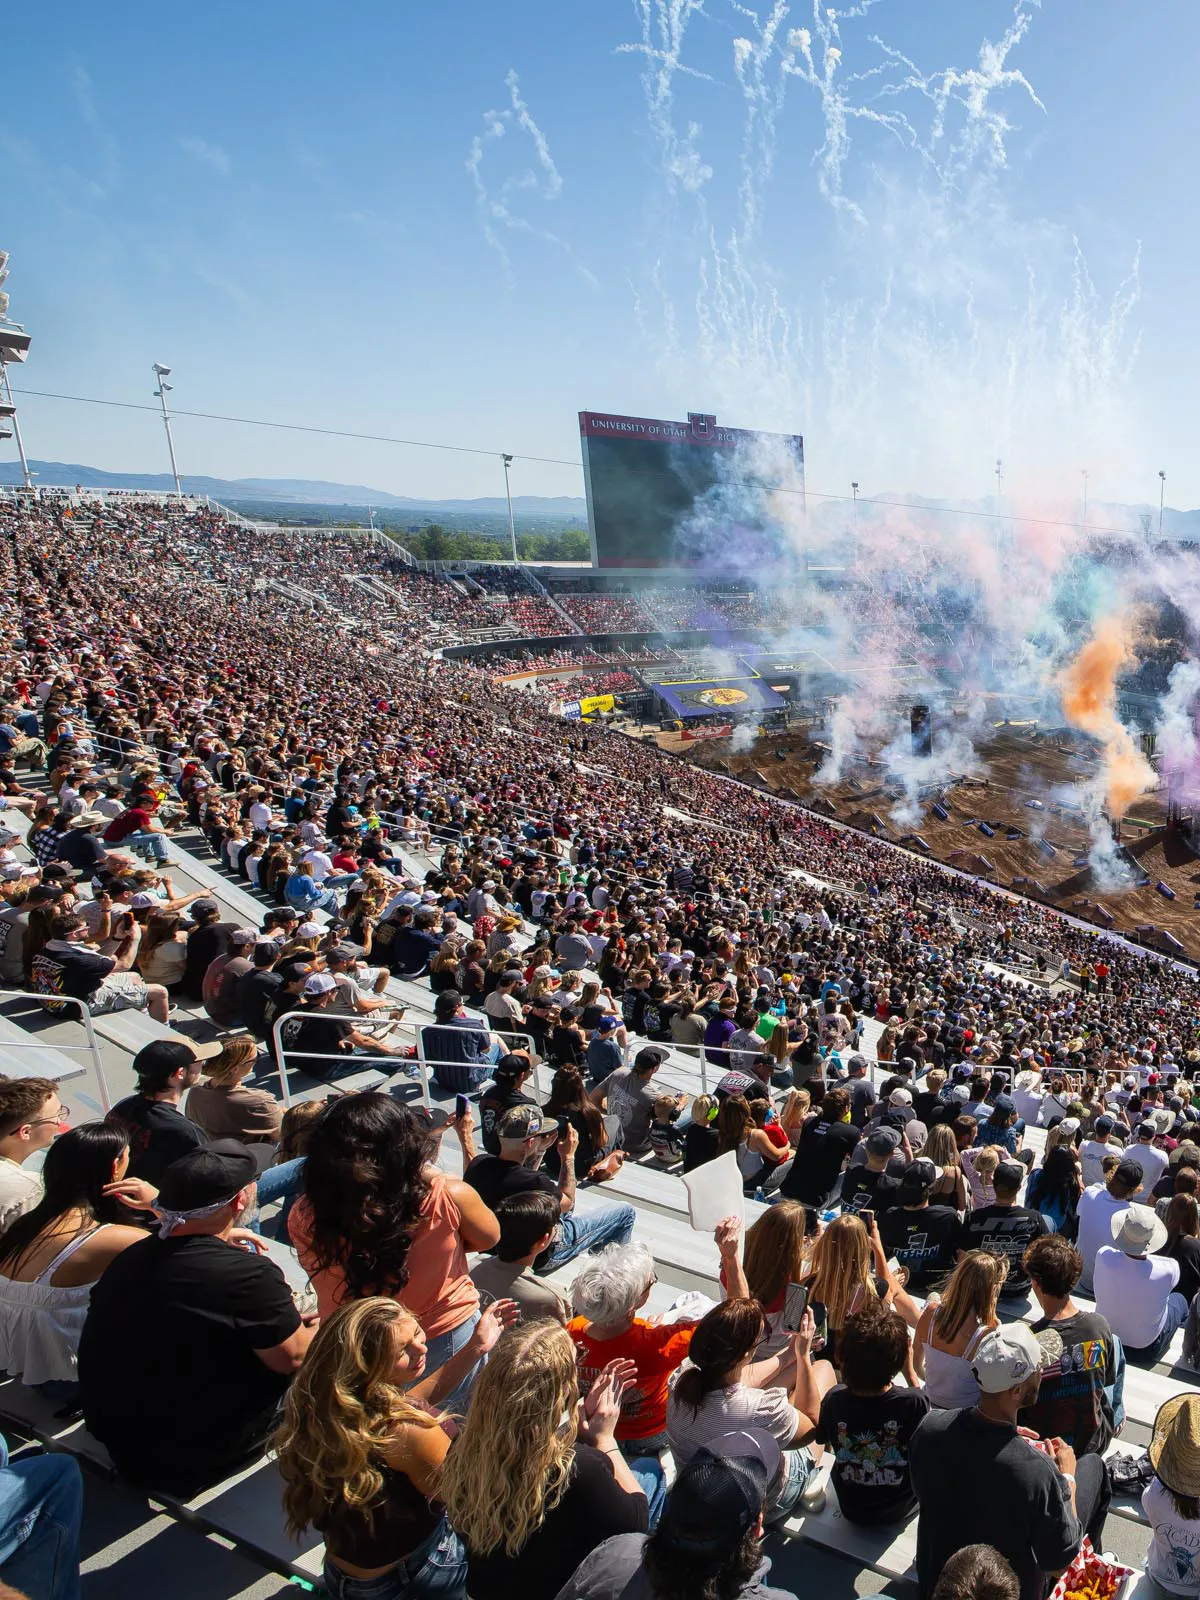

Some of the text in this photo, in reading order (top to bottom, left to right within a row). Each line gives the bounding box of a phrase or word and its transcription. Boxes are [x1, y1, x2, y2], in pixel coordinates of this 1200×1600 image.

[591, 419, 687, 437] UNIVERSITY OF UTAH
